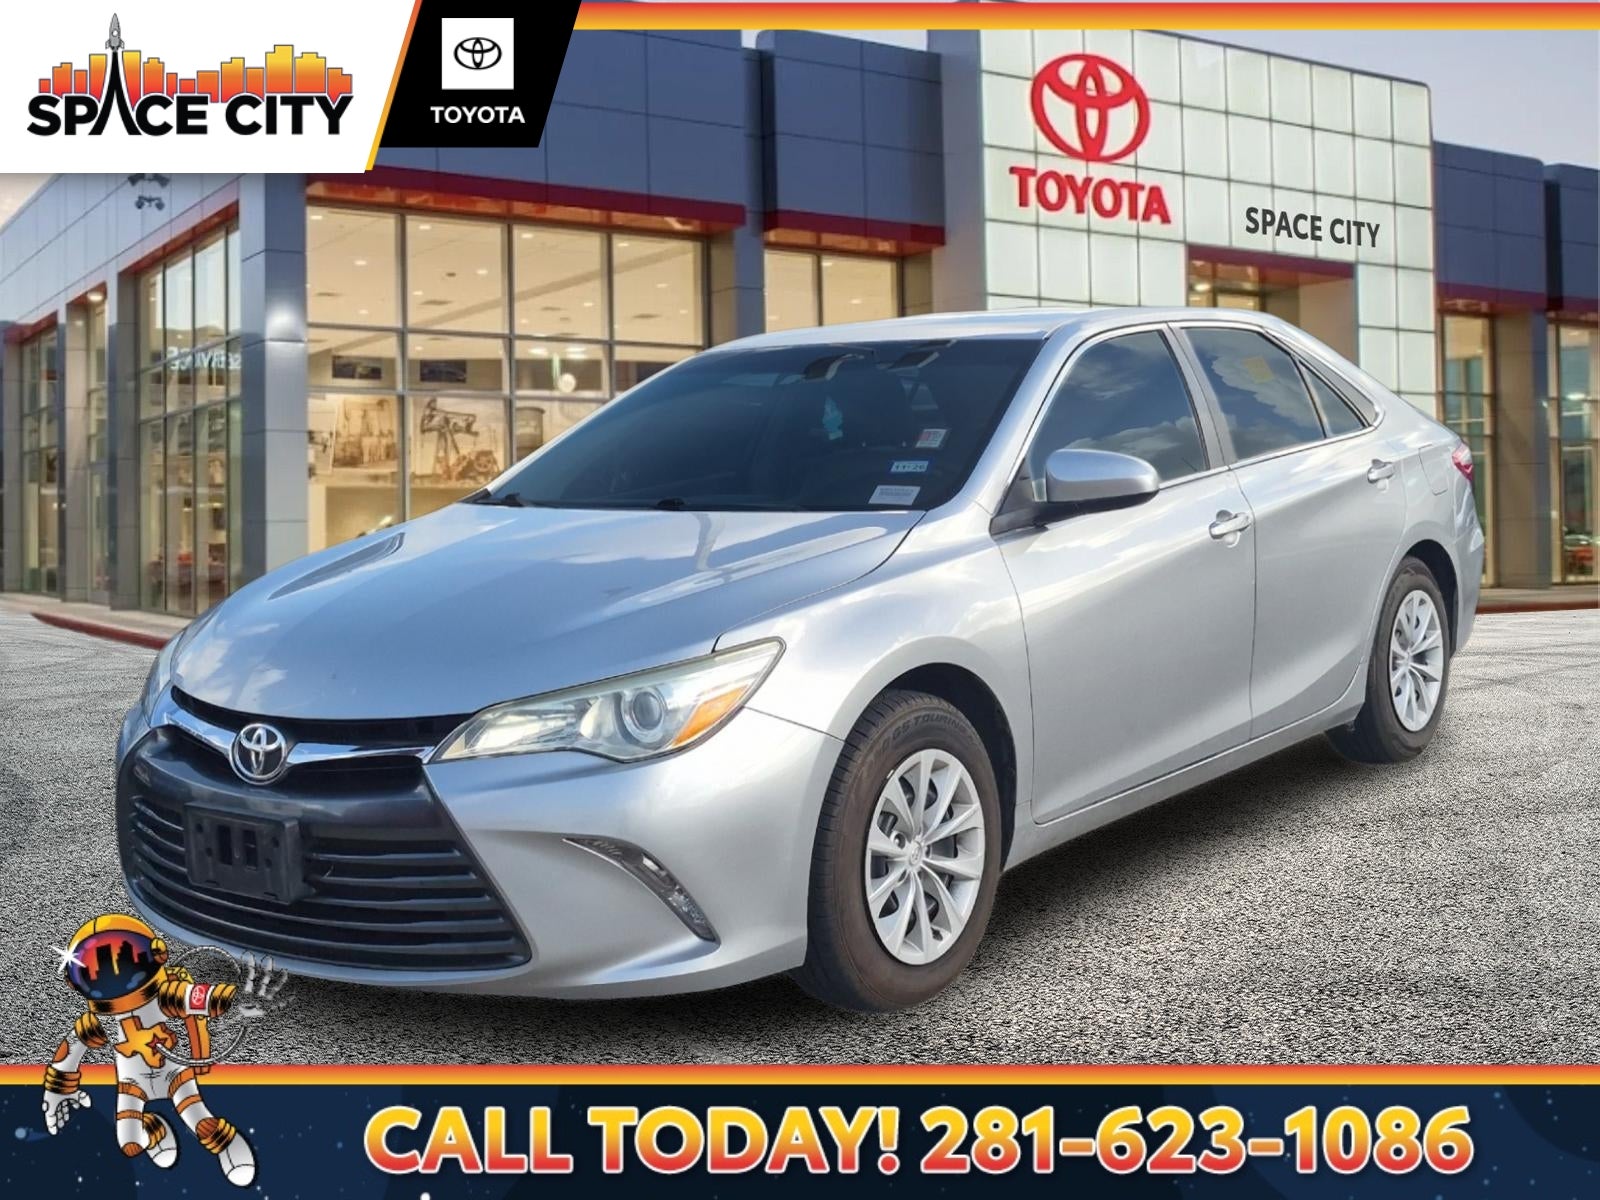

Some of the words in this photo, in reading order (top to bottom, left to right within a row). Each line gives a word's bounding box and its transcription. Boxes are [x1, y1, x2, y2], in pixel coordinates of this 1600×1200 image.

[1009, 166, 1171, 224] TOYOTA
[1245, 206, 1323, 242] SPACE
[1329, 217, 1381, 248] CITY
